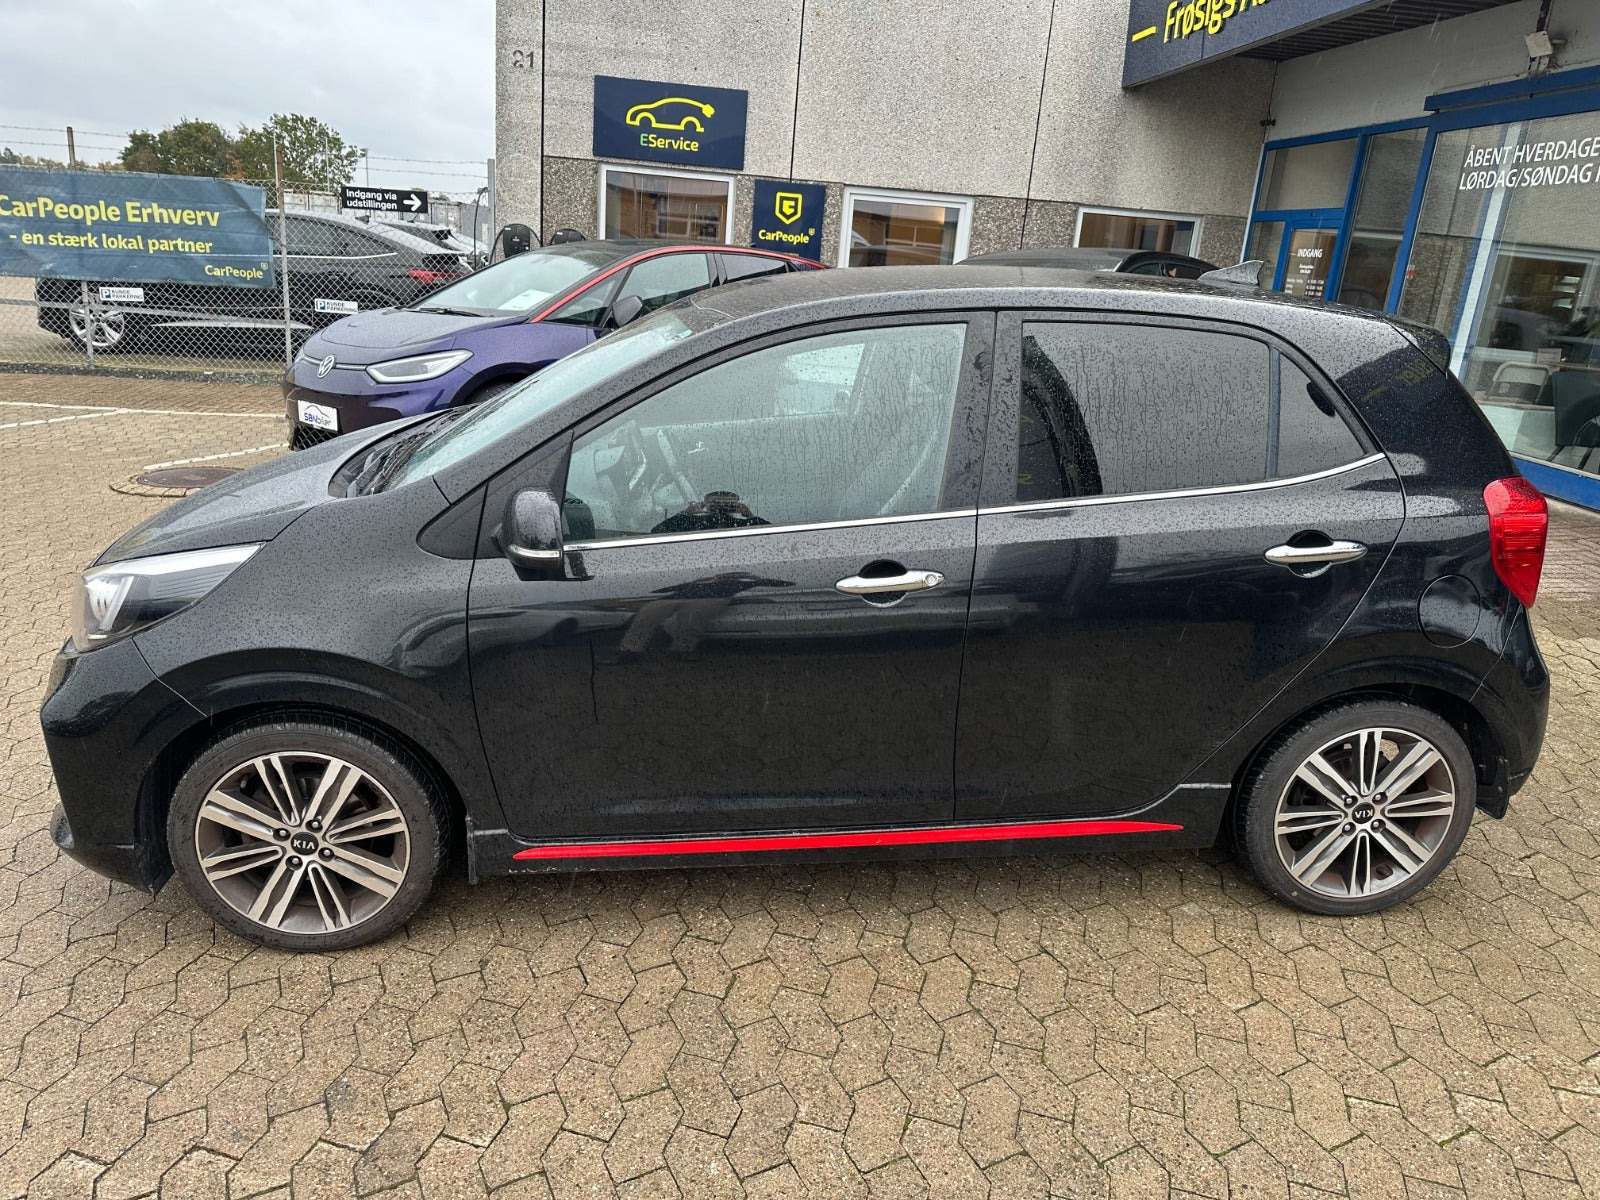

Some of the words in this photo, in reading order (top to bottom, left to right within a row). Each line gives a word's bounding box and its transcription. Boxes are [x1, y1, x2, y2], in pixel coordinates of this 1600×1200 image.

[640, 133, 699, 152] EService
[1463, 144, 1513, 168] ÅBENT
[1459, 163, 1594, 191] LØRDAG/SØNDAG
[346, 188, 382, 201] Indgang
[384, 192, 398, 200] via
[0, 194, 121, 226] CarPeople
[125, 201, 220, 227] Erhverv
[346, 199, 398, 211] udstillingen
[21, 232, 45, 245] en
[47, 231, 98, 248] stærk
[102, 233, 144, 250] lokal
[148, 237, 213, 254] partner
[758, 229, 810, 245] CarPeople
[1297, 248, 1323, 258] INDGANG
[204, 264, 264, 280] CarPeople
[293, 839, 316, 850] KIA
